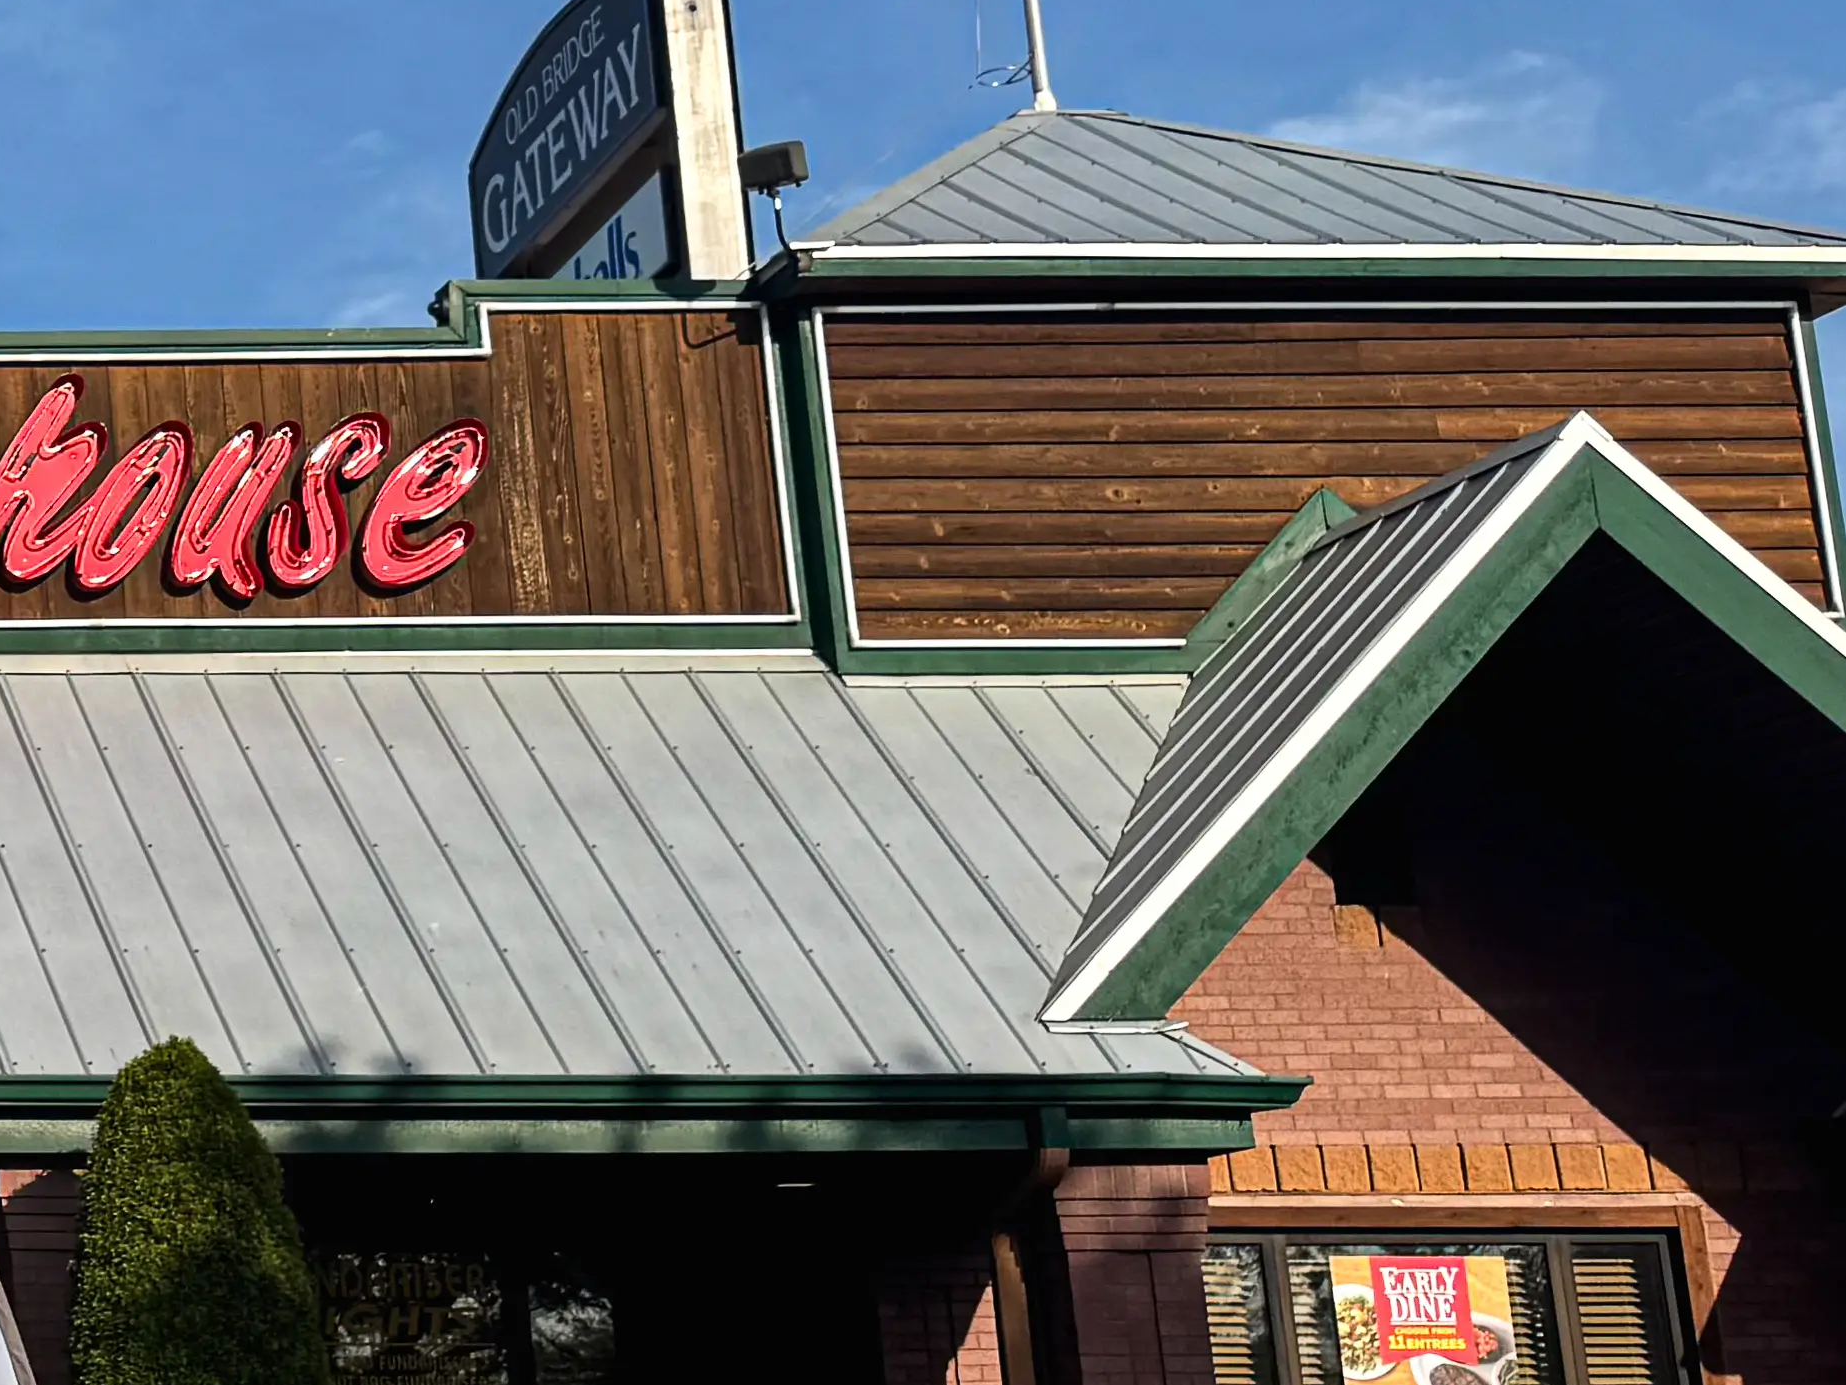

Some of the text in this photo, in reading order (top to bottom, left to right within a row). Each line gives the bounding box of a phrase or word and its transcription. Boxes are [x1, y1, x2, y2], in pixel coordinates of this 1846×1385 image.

[505, 5, 605, 145] OLD BRIDGE
[482, 22, 641, 254] GATEWAY
[1379, 1267, 1459, 1295] EARLY
[1388, 1293, 1457, 1322] DINE
[1405, 1338, 1467, 1350] ENTREES
